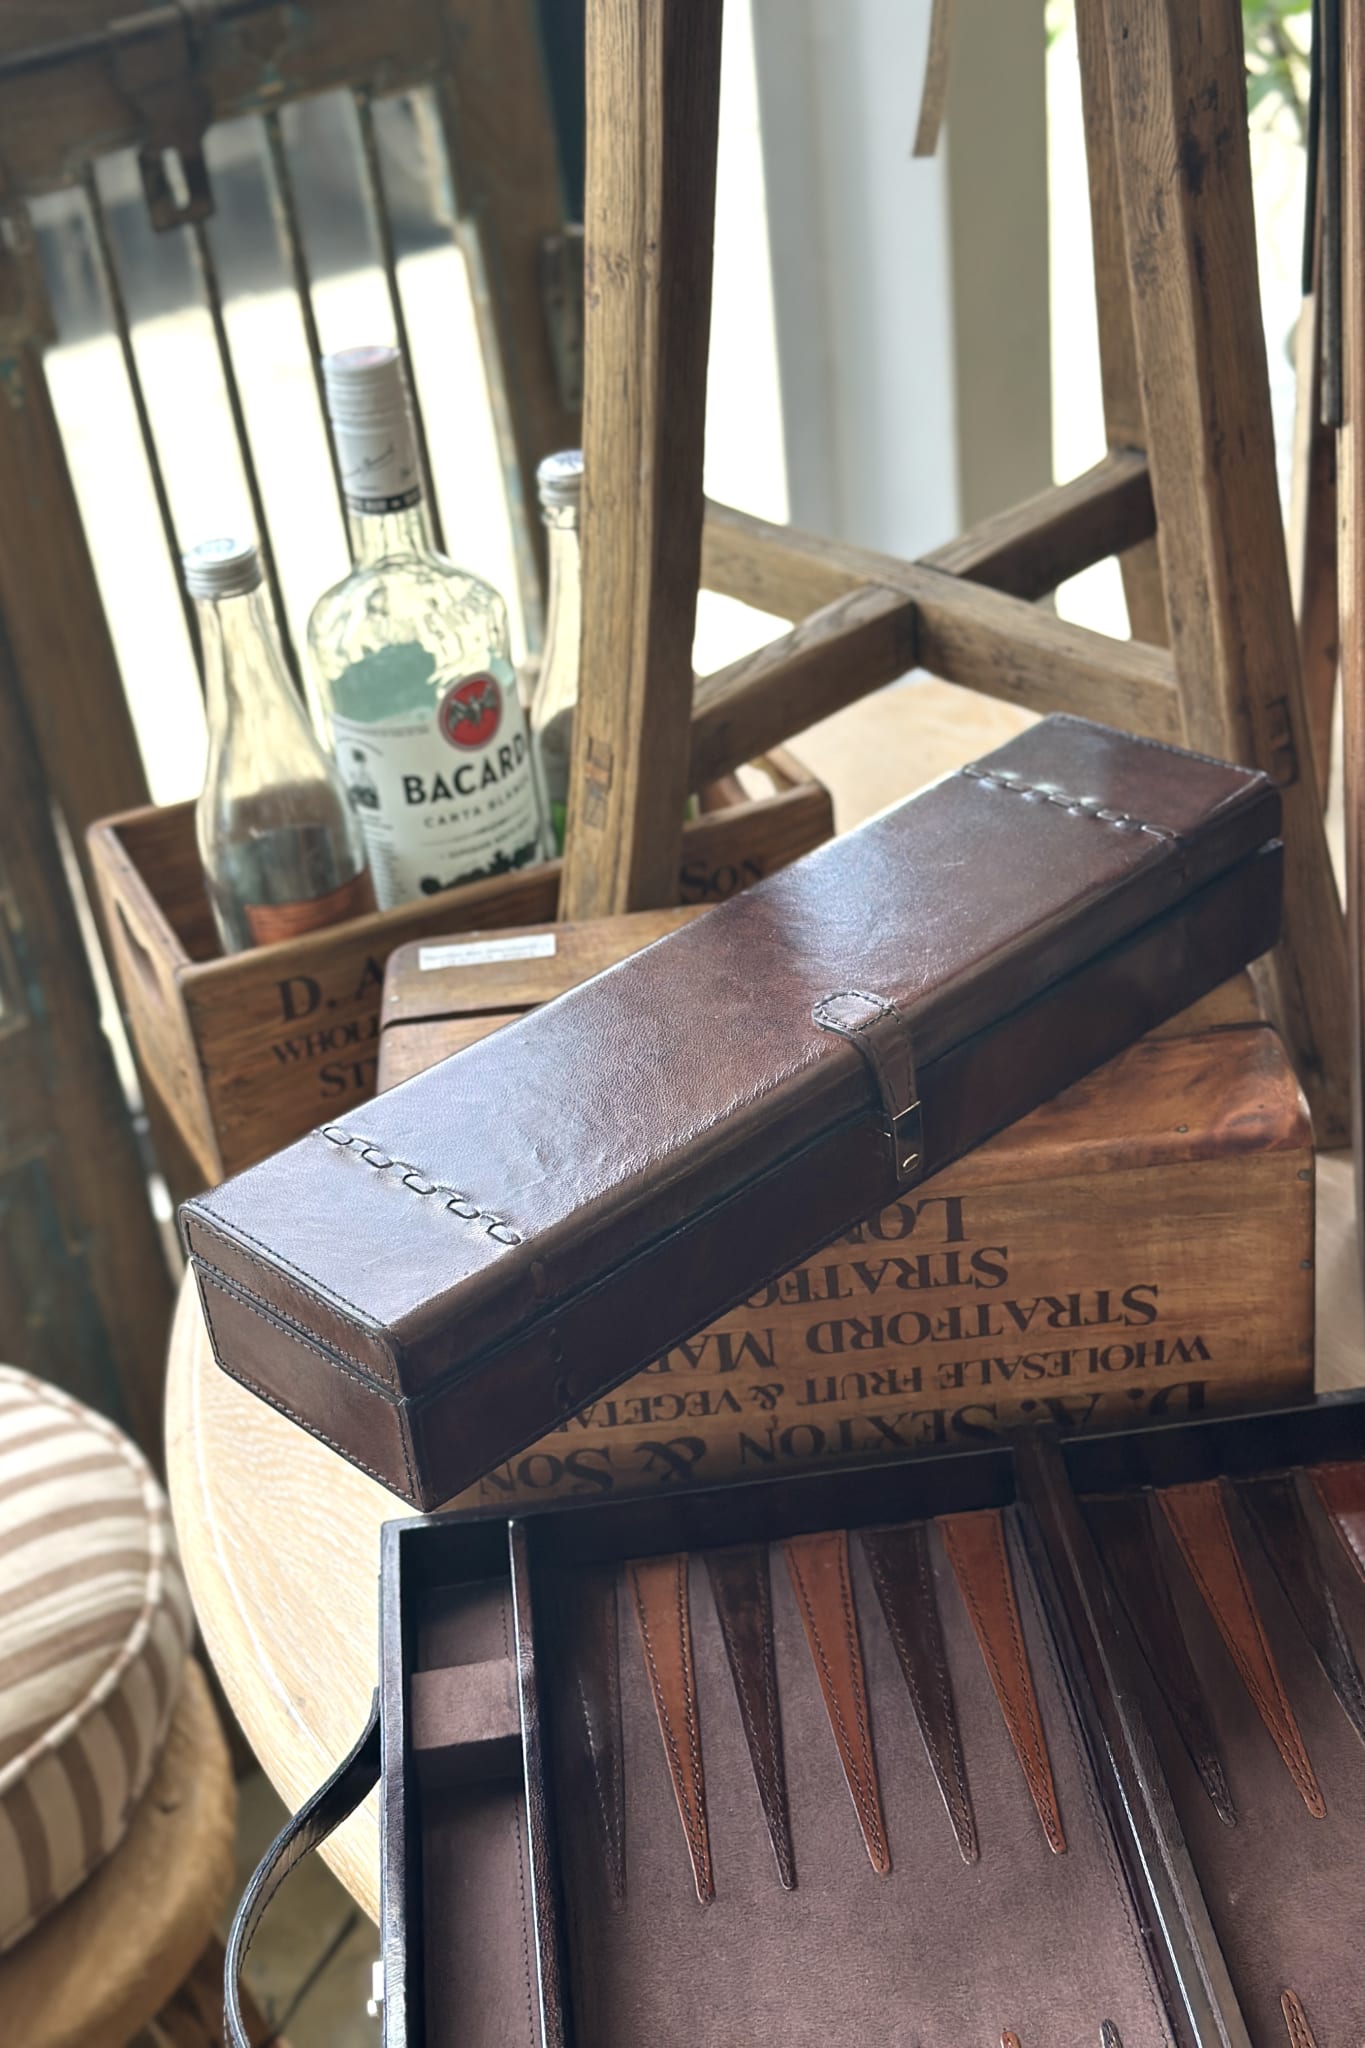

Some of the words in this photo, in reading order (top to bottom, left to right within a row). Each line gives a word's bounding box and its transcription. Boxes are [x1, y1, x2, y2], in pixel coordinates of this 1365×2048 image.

[275, 974, 337, 1022] D.
[806, 1284, 1159, 1354] STRATFORD
[796, 1366, 924, 1406] FRUIT
[938, 1335, 1213, 1390] WHOLESALE
[552, 1390, 743, 1434] VEGETA
[748, 1382, 785, 1411] &
[738, 1401, 1003, 1465] SEXTON
[631, 1435, 707, 1483] &
